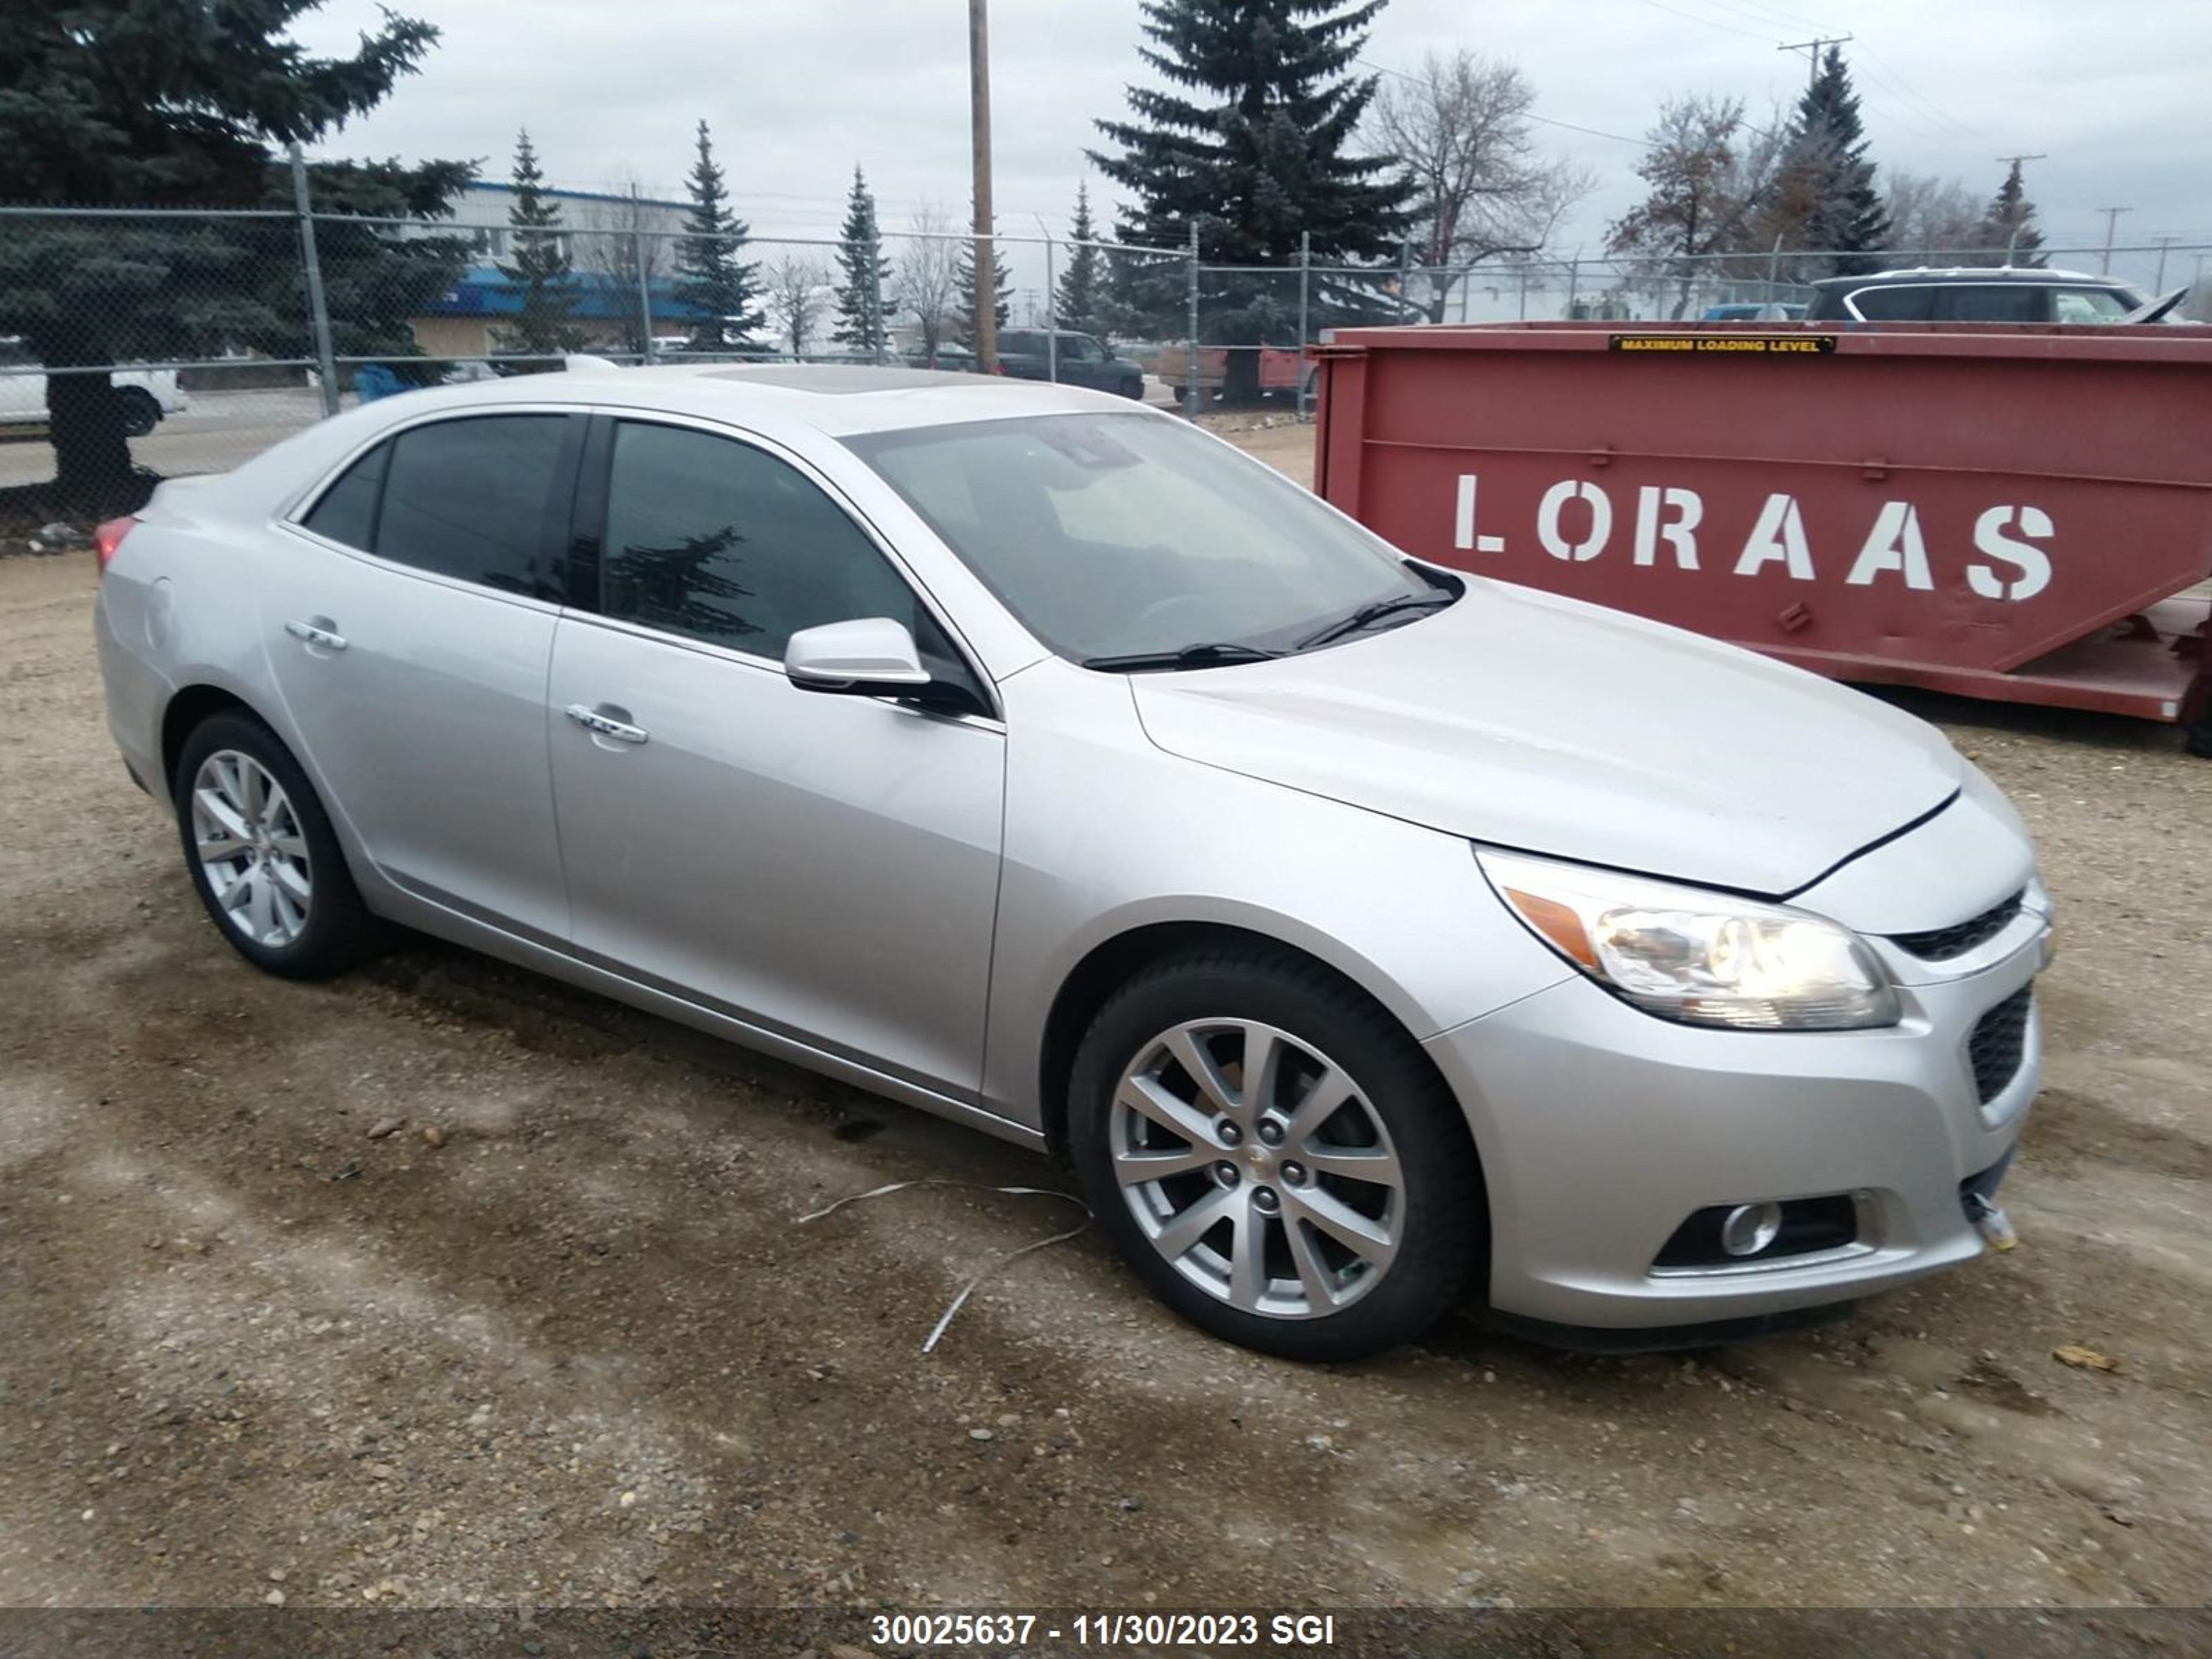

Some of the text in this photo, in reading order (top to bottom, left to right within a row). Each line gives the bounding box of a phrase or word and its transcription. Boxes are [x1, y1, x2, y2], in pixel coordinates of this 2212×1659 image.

[1621, 339, 1819, 352] MAXIMUM LOADING LEVEL
[1454, 474, 2054, 601] LORAAS
